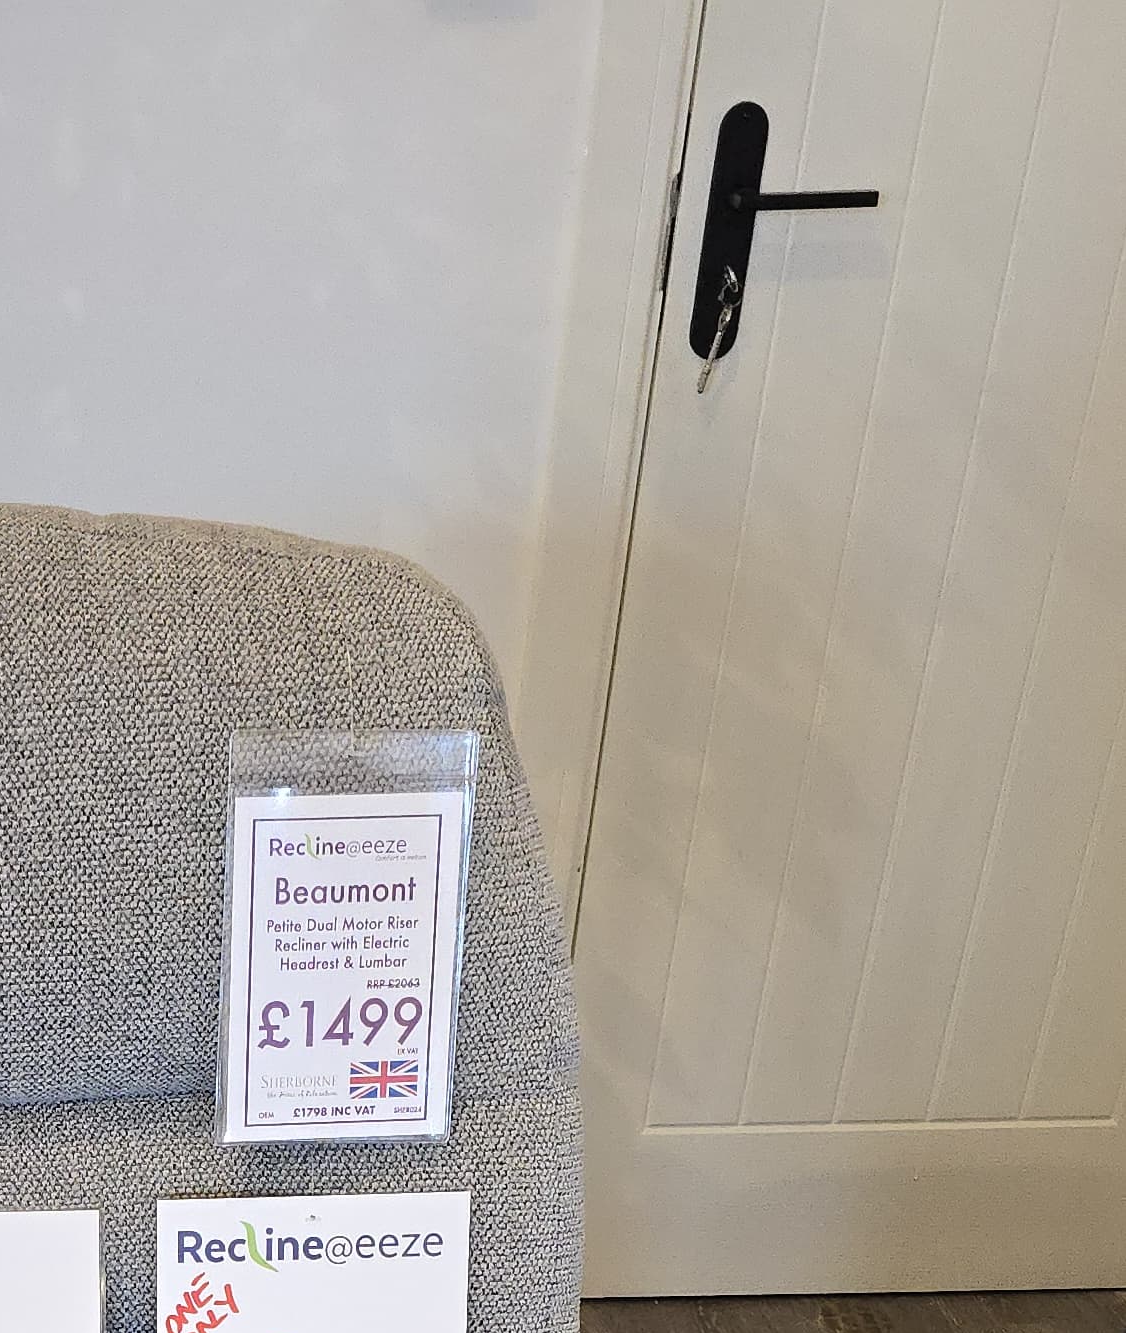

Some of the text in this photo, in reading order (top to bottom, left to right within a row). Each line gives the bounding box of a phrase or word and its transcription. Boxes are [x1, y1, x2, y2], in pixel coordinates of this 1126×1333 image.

[275, 877, 416, 905] Beaumont
[267, 915, 418, 933] Petite Dual Motor Riser
[275, 935, 409, 952] Recliner with Electric
[280, 955, 407, 971] Headrest & Lumbar
[257, 995, 423, 1049] £1499
[293, 1106, 327, 1118] £1798
[331, 1106, 351, 1117] INC
[355, 1105, 376, 1116] VAT
